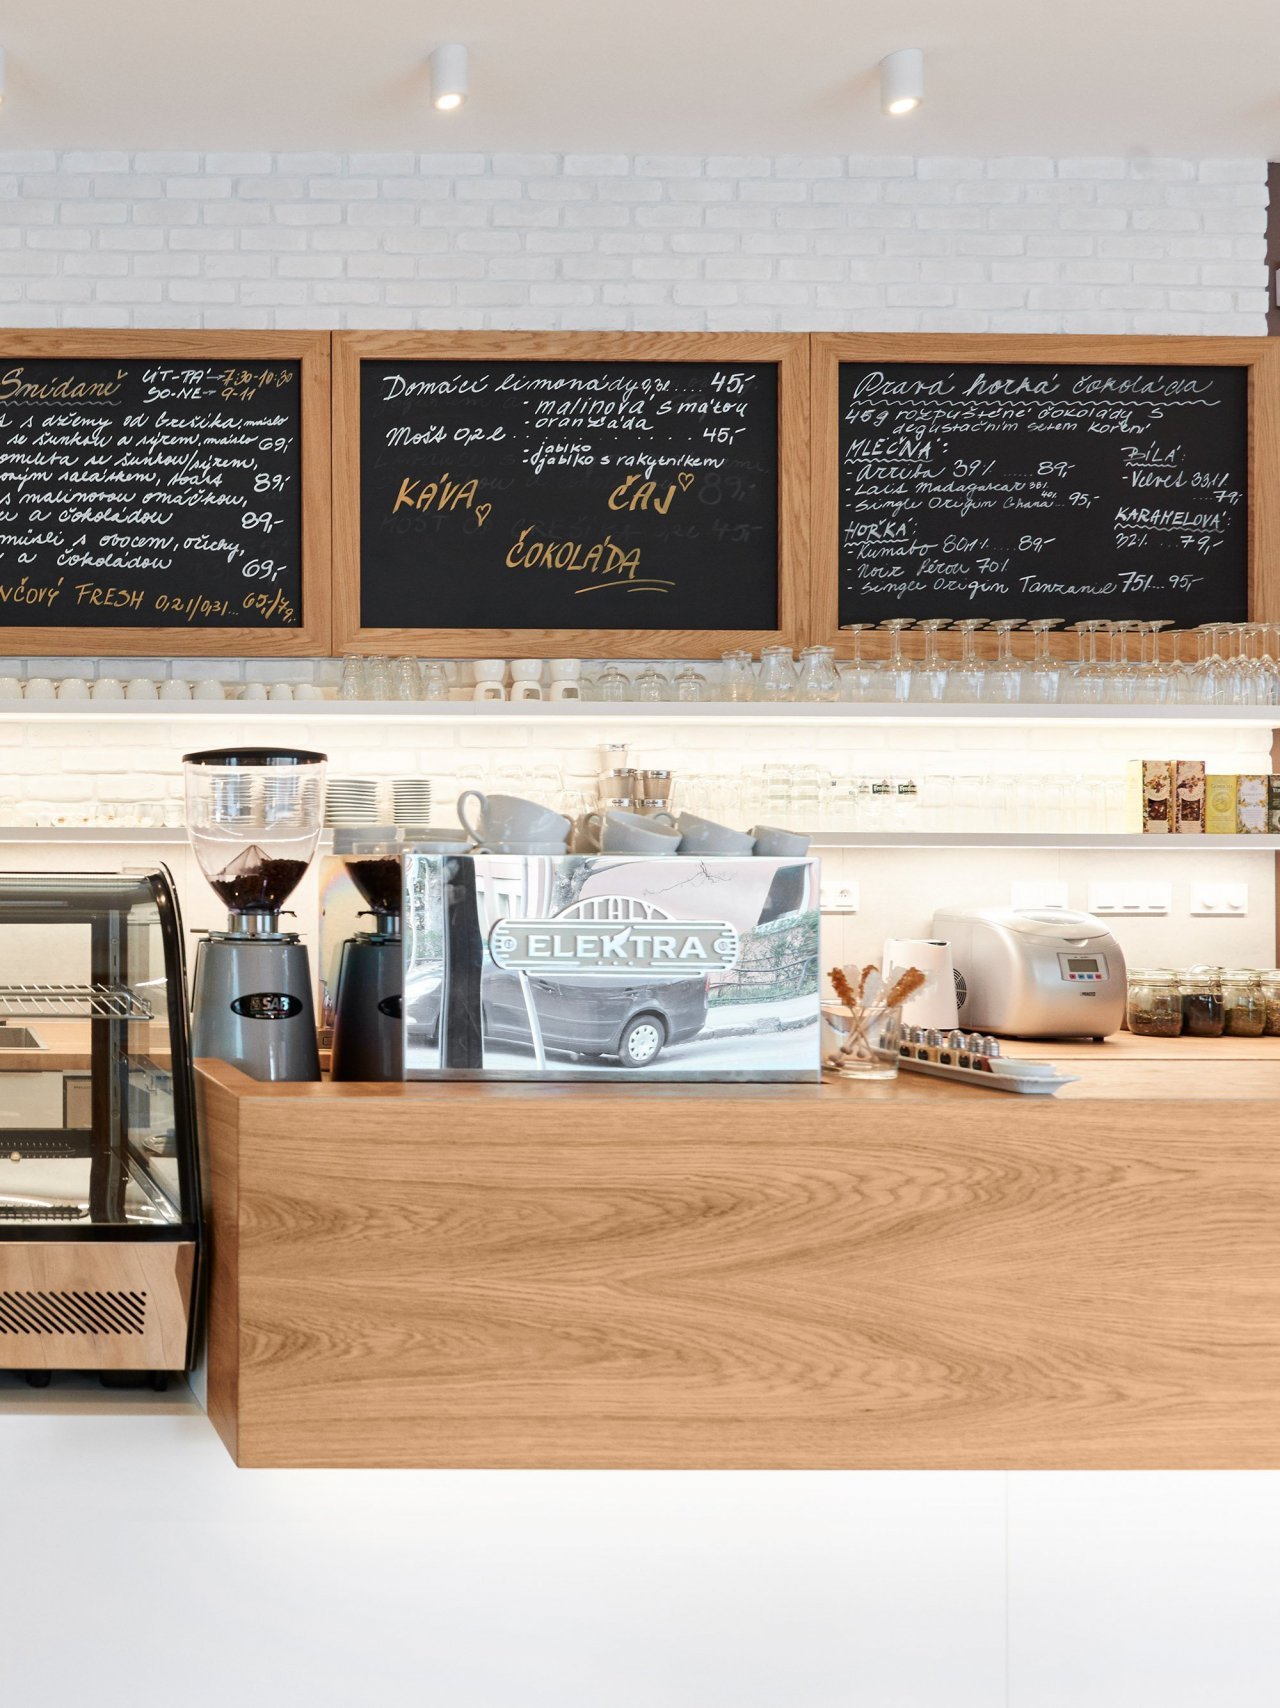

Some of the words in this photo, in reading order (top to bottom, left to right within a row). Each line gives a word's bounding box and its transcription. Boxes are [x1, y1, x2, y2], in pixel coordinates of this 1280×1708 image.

[382, 374, 490, 401] Domácí
[494, 373, 639, 402] limonády
[852, 371, 956, 400] Pravá
[962, 372, 1061, 397] horká
[1072, 374, 1214, 397] čokoláda
[534, 393, 656, 416] malinová
[656, 400, 673, 416] s
[676, 398, 750, 417] mátou
[1037, 405, 1133, 425] čokolády
[20, 416, 33, 429] s
[122, 412, 149, 428] od
[1027, 421, 1078, 432] setem
[6, 435, 29, 446] se
[117, 435, 133, 447] a
[385, 425, 447, 447] Mošt
[84, 454, 113, 467] se
[530, 441, 593, 466] jablko
[534, 453, 595, 475] jablko
[599, 454, 611, 466] s
[855, 463, 947, 482] Arriba
[1131, 469, 1189, 488] Velvet
[18, 489, 137, 505] malinovou
[392, 472, 480, 514] KÁVA
[607, 473, 677, 516] ČAJ
[28, 508, 52, 522] a
[58, 506, 174, 525] čokoládou
[854, 498, 923, 518] Single
[927, 496, 997, 518] Origin
[72, 534, 86, 547] s
[17, 552, 38, 564] a
[56, 548, 173, 570] čokoládou
[504, 524, 643, 580] ČOKOLÁDA
[74, 582, 145, 610] FRESH
[860, 580, 927, 600] Single
[933, 577, 1009, 600] Origin
[577, 897, 655, 920] ITALY
[527, 926, 707, 959] ELEKTRA
